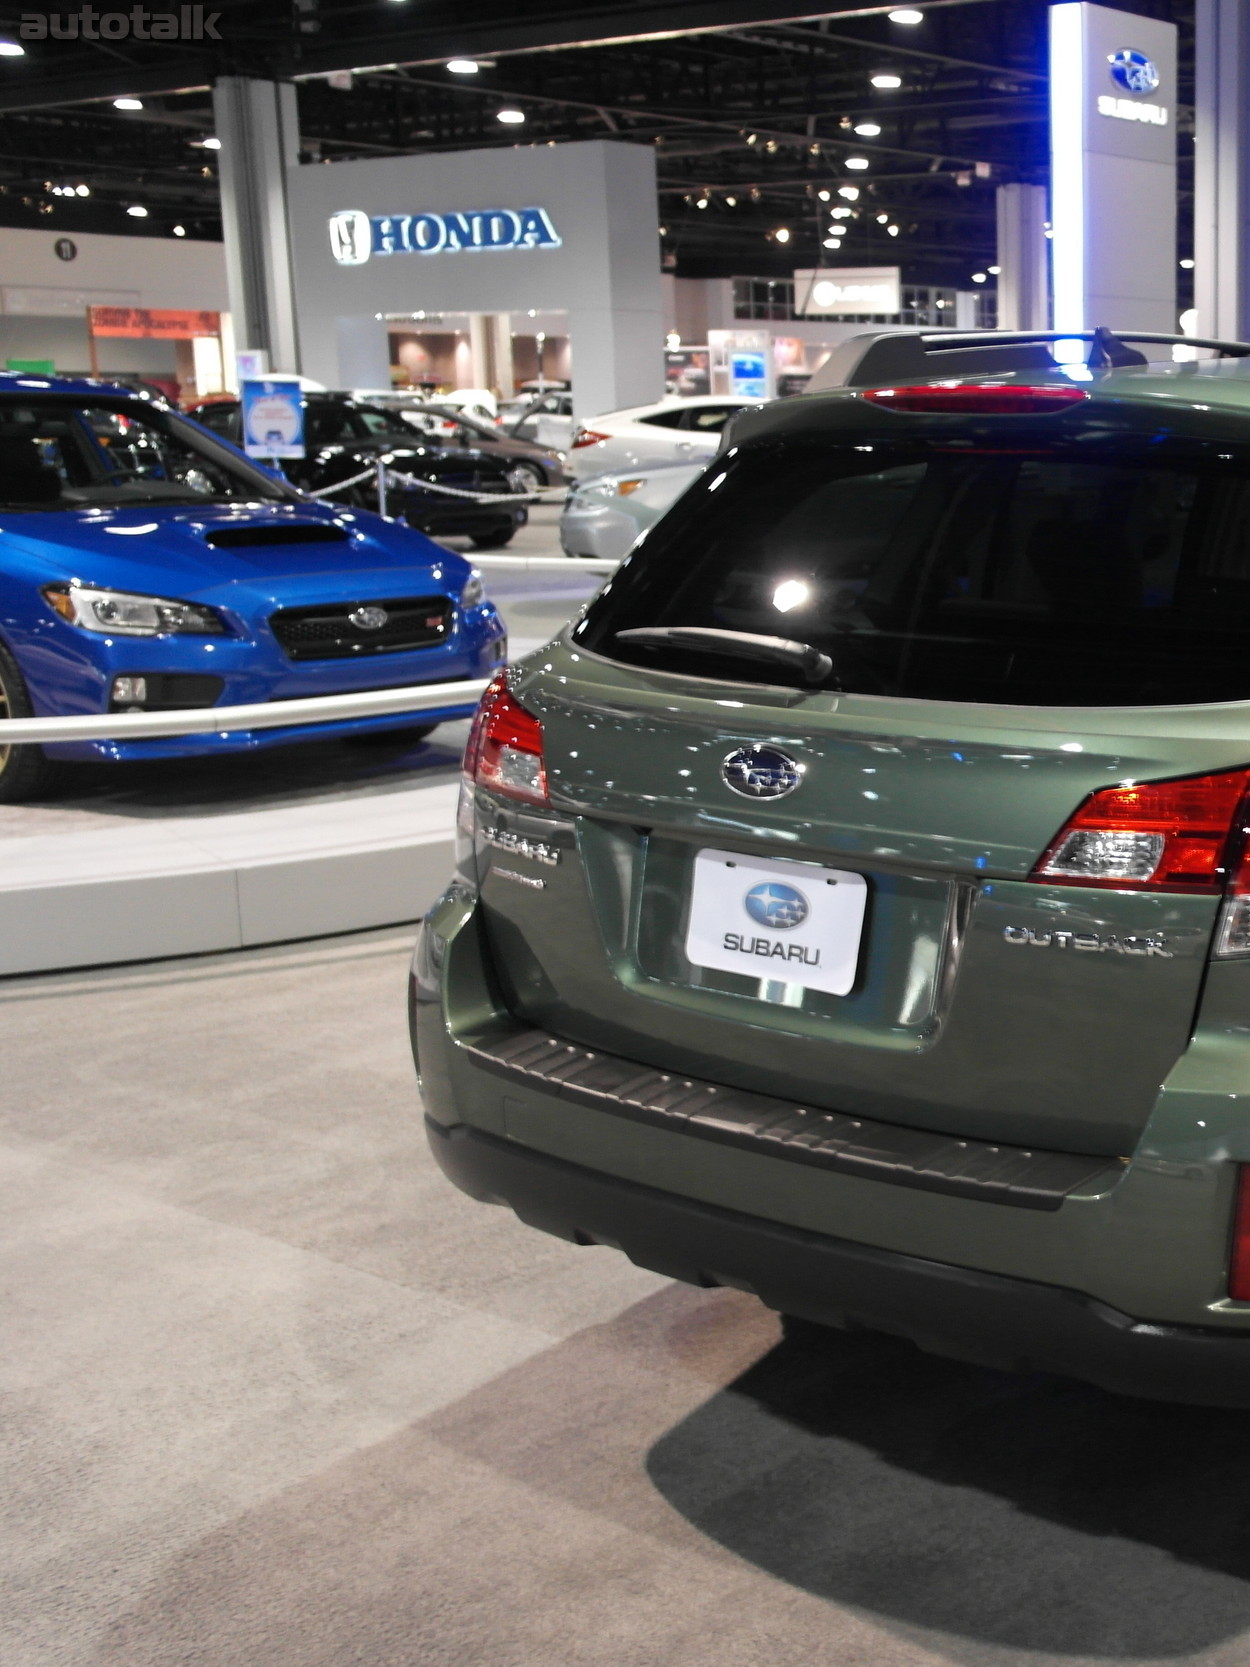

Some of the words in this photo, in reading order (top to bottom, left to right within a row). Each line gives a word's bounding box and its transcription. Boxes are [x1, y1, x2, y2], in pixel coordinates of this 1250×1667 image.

[371, 206, 563, 256] HONDA
[723, 932, 821, 966] SUBARU
[1004, 926, 1174, 958] OUTBACK
